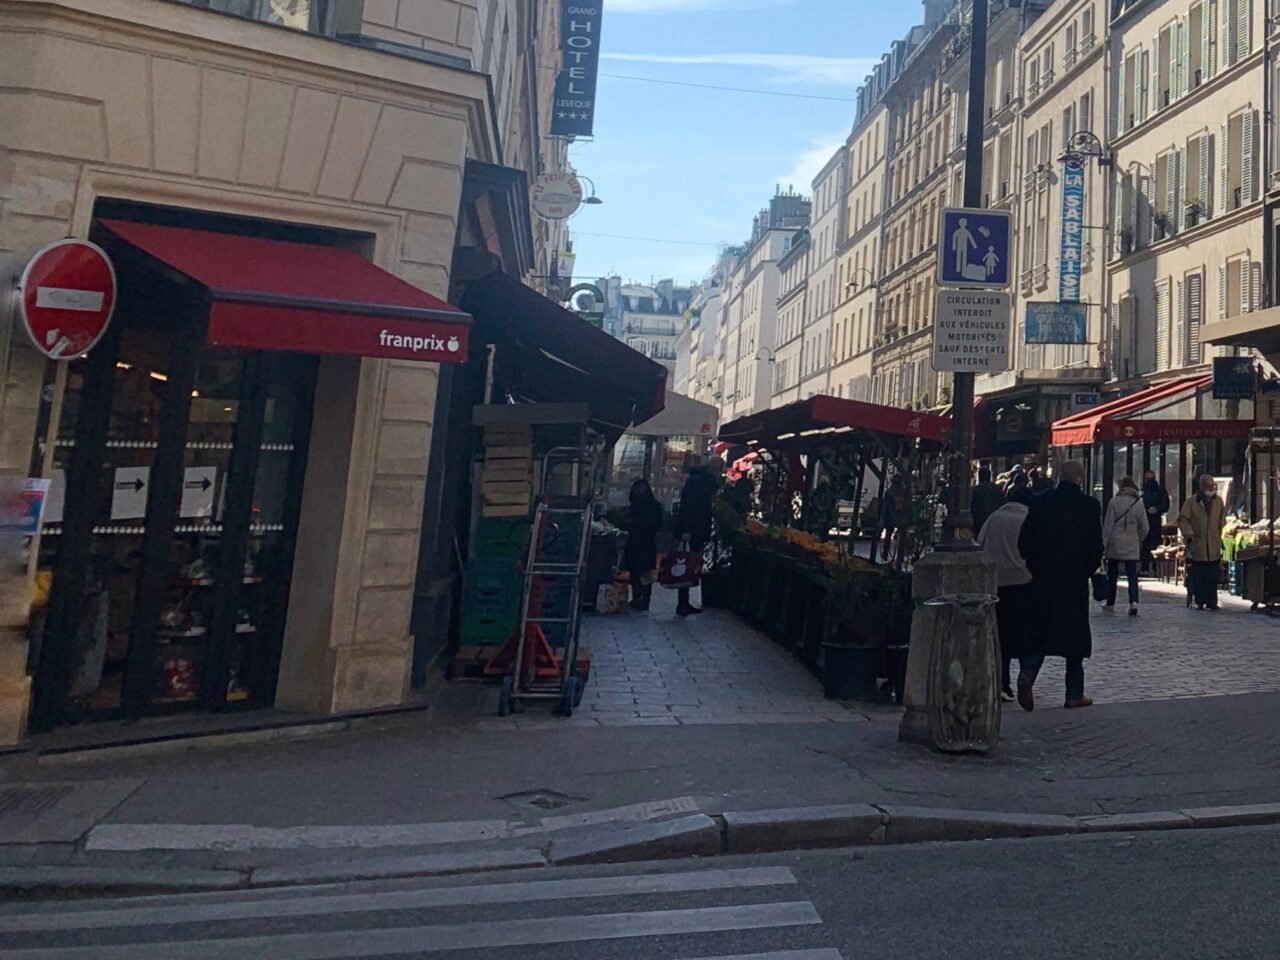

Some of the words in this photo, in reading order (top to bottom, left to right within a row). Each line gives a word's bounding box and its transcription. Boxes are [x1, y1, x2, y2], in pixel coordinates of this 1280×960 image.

[568, 6, 596, 16] GRAND
[567, 20, 592, 94] HOTEL
[1065, 174, 1083, 186] LA
[1063, 195, 1082, 300] SABLAISE
[946, 296, 1001, 305] CIRCULATION
[953, 309, 992, 317] INTERDIT
[939, 321, 956, 329] AUX
[959, 320, 1006, 330] VÉHICULES
[379, 329, 444, 352] franprix
[938, 344, 961, 353] SAUF
[952, 357, 990, 366] INTERNE
